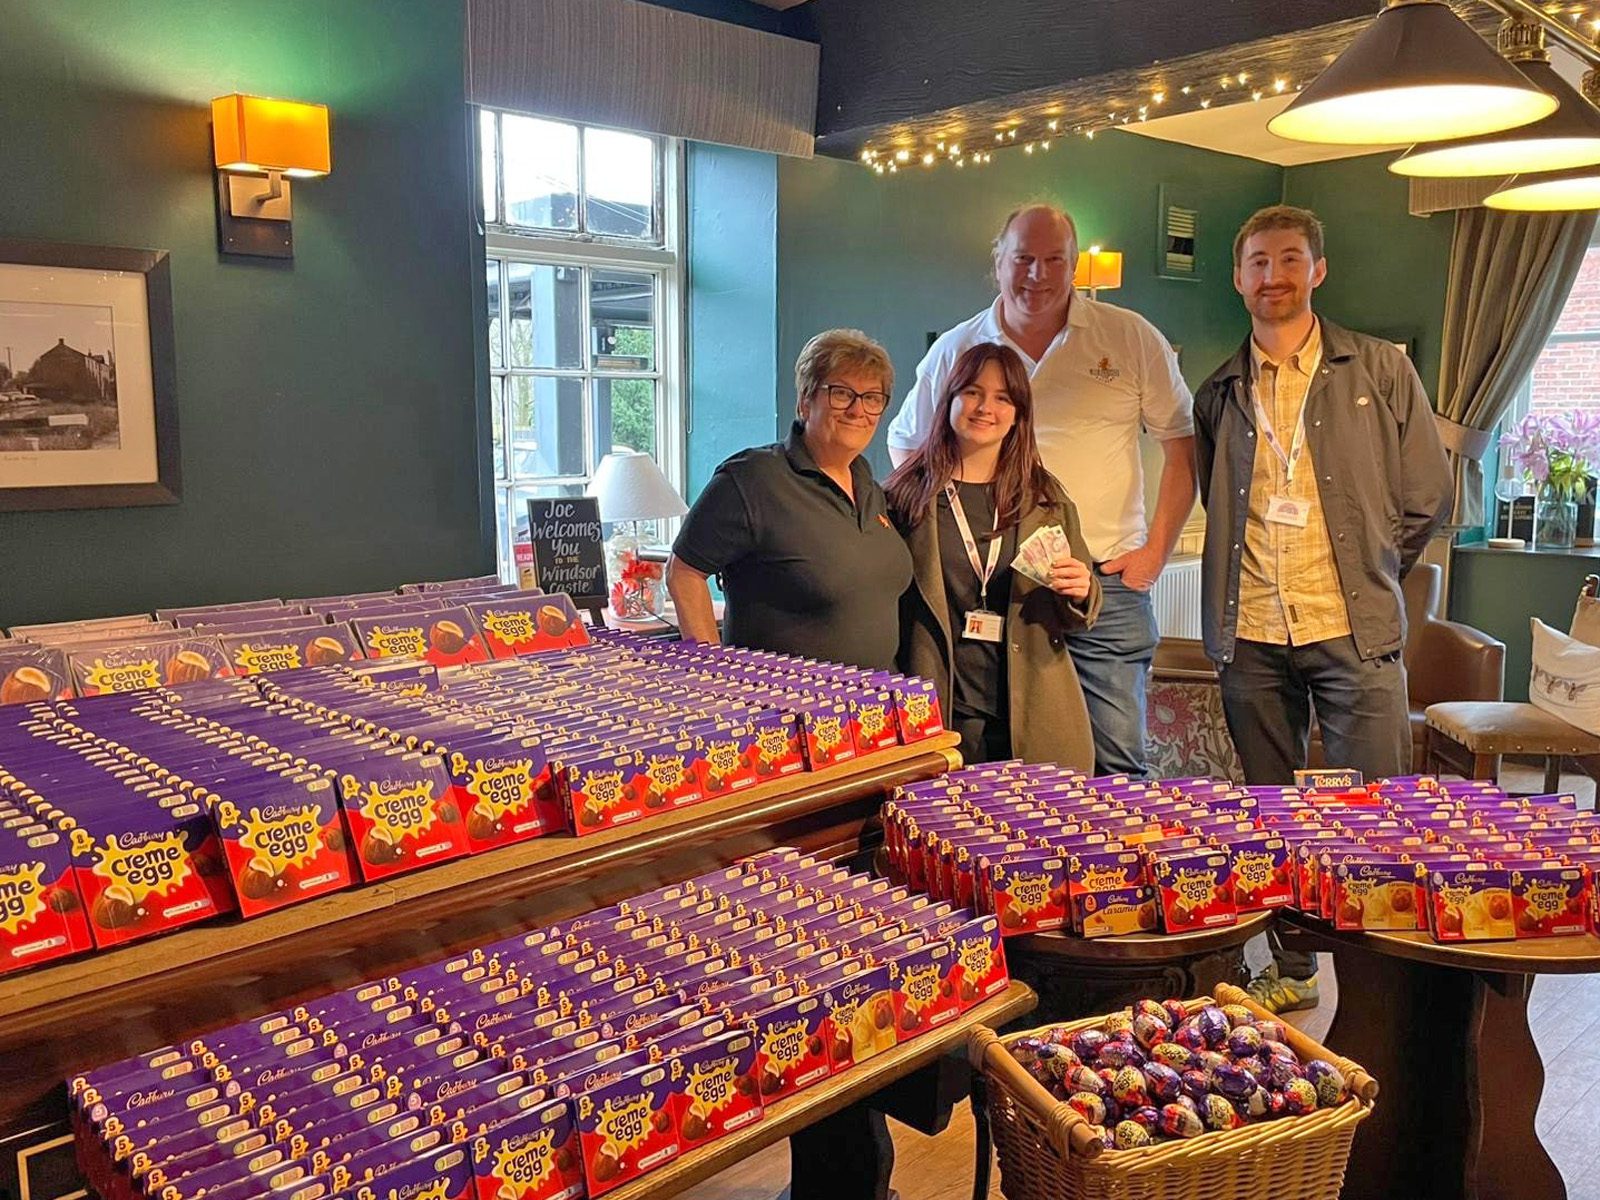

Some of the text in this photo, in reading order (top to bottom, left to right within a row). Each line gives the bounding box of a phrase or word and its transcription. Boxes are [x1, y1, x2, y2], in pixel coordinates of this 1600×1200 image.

[545, 501, 576, 518] Joe
[551, 539, 581, 558] You
[542, 565, 600, 582] Windsor
[492, 618, 530, 631] creme
[502, 626, 527, 638] egg
[379, 634, 420, 648] creme
[389, 643, 417, 655] egg
[247, 652, 294, 666] creme
[99, 669, 152, 686] creme
[762, 734, 785, 749] creme
[766, 742, 783, 755] egg
[711, 748, 737, 764] creme
[717, 757, 734, 770] egg
[653, 762, 681, 780] creme
[658, 771, 678, 786] egg
[479, 773, 527, 796] creme
[589, 779, 619, 796] creme
[490, 785, 521, 805] egg
[596, 787, 616, 802] egg
[261, 805, 301, 821] Cadbury
[374, 795, 428, 819] creme
[387, 807, 422, 828] egg
[120, 831, 165, 848] Cadbury
[255, 820, 314, 848] creme
[269, 835, 308, 858] egg
[111, 847, 181, 876] creme
[1239, 860, 1271, 876] creme
[127, 861, 173, 886] egg
[1088, 875, 1121, 889] creme
[1246, 870, 1267, 884] egg
[1013, 880, 1048, 897] creme
[1179, 878, 1213, 895] creme
[1020, 891, 1043, 905] egg
[1186, 889, 1208, 903] egg
[1531, 892, 1564, 903] creme
[1537, 900, 1559, 912] egg
[964, 947, 990, 965] creme
[971, 958, 987, 972] egg
[908, 973, 937, 994] creme
[915, 986, 933, 1001] egg
[769, 1030, 804, 1055] creme
[777, 1044, 799, 1061] egg
[694, 1070, 732, 1096] creme
[702, 1084, 727, 1103] egg
[606, 1105, 648, 1136] creme
[615, 1122, 643, 1142] egg
[503, 1144, 549, 1177] creme
[513, 1161, 543, 1184] egg
